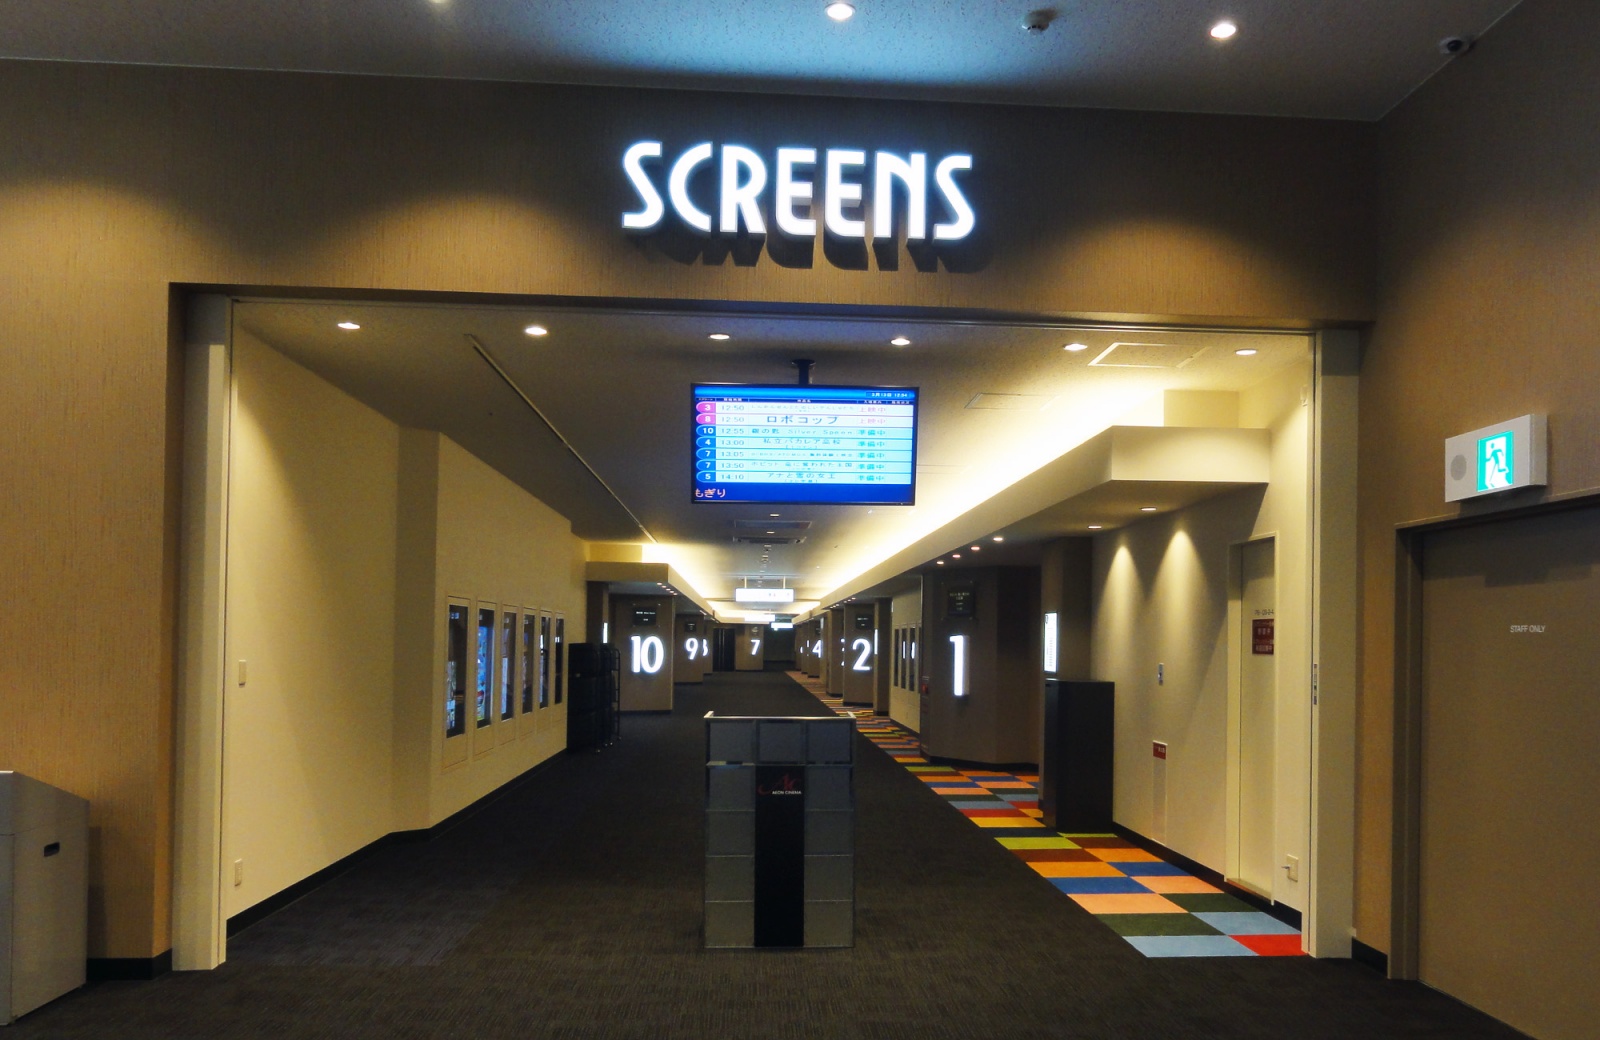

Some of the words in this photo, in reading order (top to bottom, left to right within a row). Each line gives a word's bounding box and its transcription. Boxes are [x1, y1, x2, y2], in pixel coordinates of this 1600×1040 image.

[622, 141, 976, 241] SCREENS
[767, 415, 838, 424] ロボコップ
[695, 487, 726, 498] もぎり
[1510, 624, 1528, 633] STAFF
[1529, 624, 1546, 633] ONLY
[630, 635, 665, 674] 10
[685, 637, 699, 660] 9
[750, 639, 761, 656] 7
[812, 639, 823, 658] 4
[852, 638, 872, 671] 2
[949, 634, 965, 697] 1
